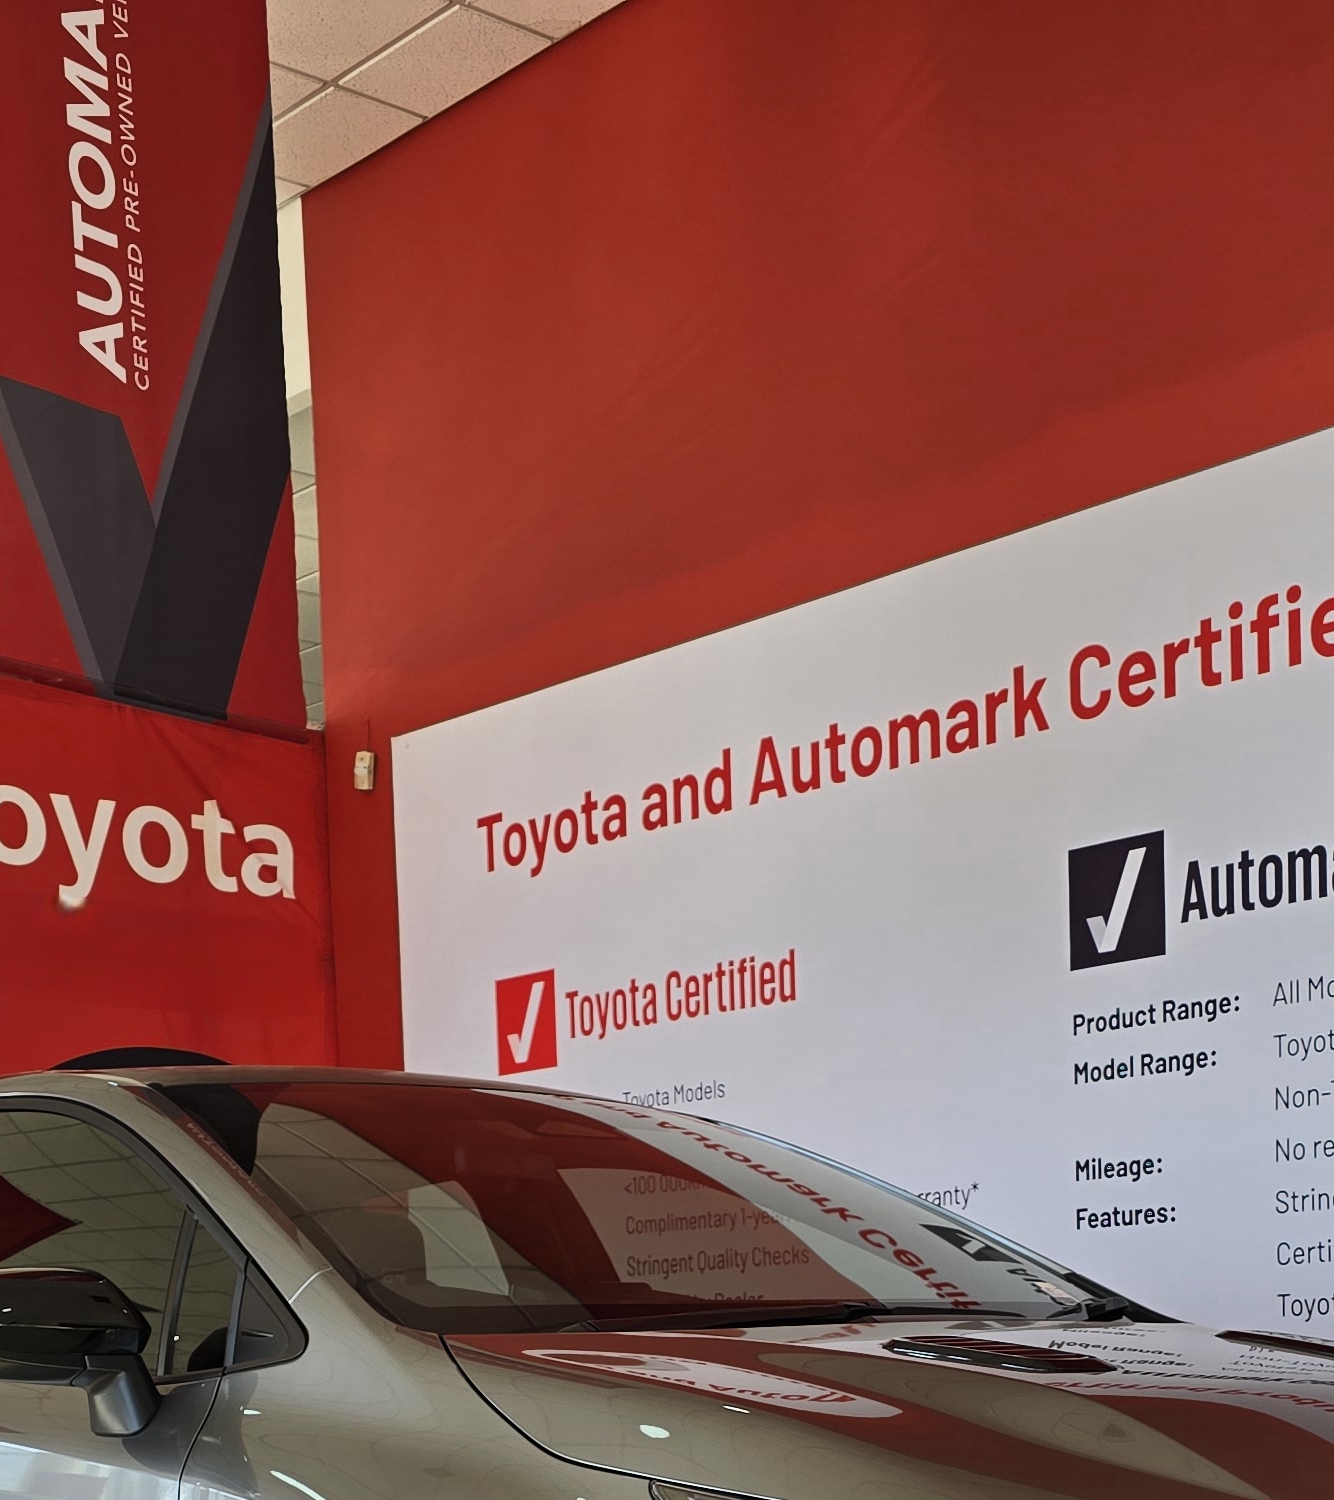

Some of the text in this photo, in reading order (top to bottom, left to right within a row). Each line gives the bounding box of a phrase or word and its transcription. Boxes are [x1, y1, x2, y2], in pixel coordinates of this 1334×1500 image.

[60, 0, 127, 384] AUTOMA
[112, 0, 150, 391] CERTIFIED PRE-OWNED VE
[477, 793, 628, 878] Toyota
[641, 748, 733, 831] and
[748, 665, 1051, 806] Automark
[565, 948, 797, 1040] Toyota Certified
[1272, 979, 1301, 1008] All
[1072, 994, 1242, 1037] Product Range:
[1073, 1048, 1219, 1086] Model Range:
[673, 1079, 726, 1105] Models
[1274, 1136, 1308, 1163] No
[1074, 1154, 1165, 1183] Mileage:
[624, 1175, 655, 1195] <100
[625, 1210, 737, 1237] Complimentary
[1074, 1203, 1178, 1232] Features:
[626, 1244, 810, 1279] Stringent Quality Checks
